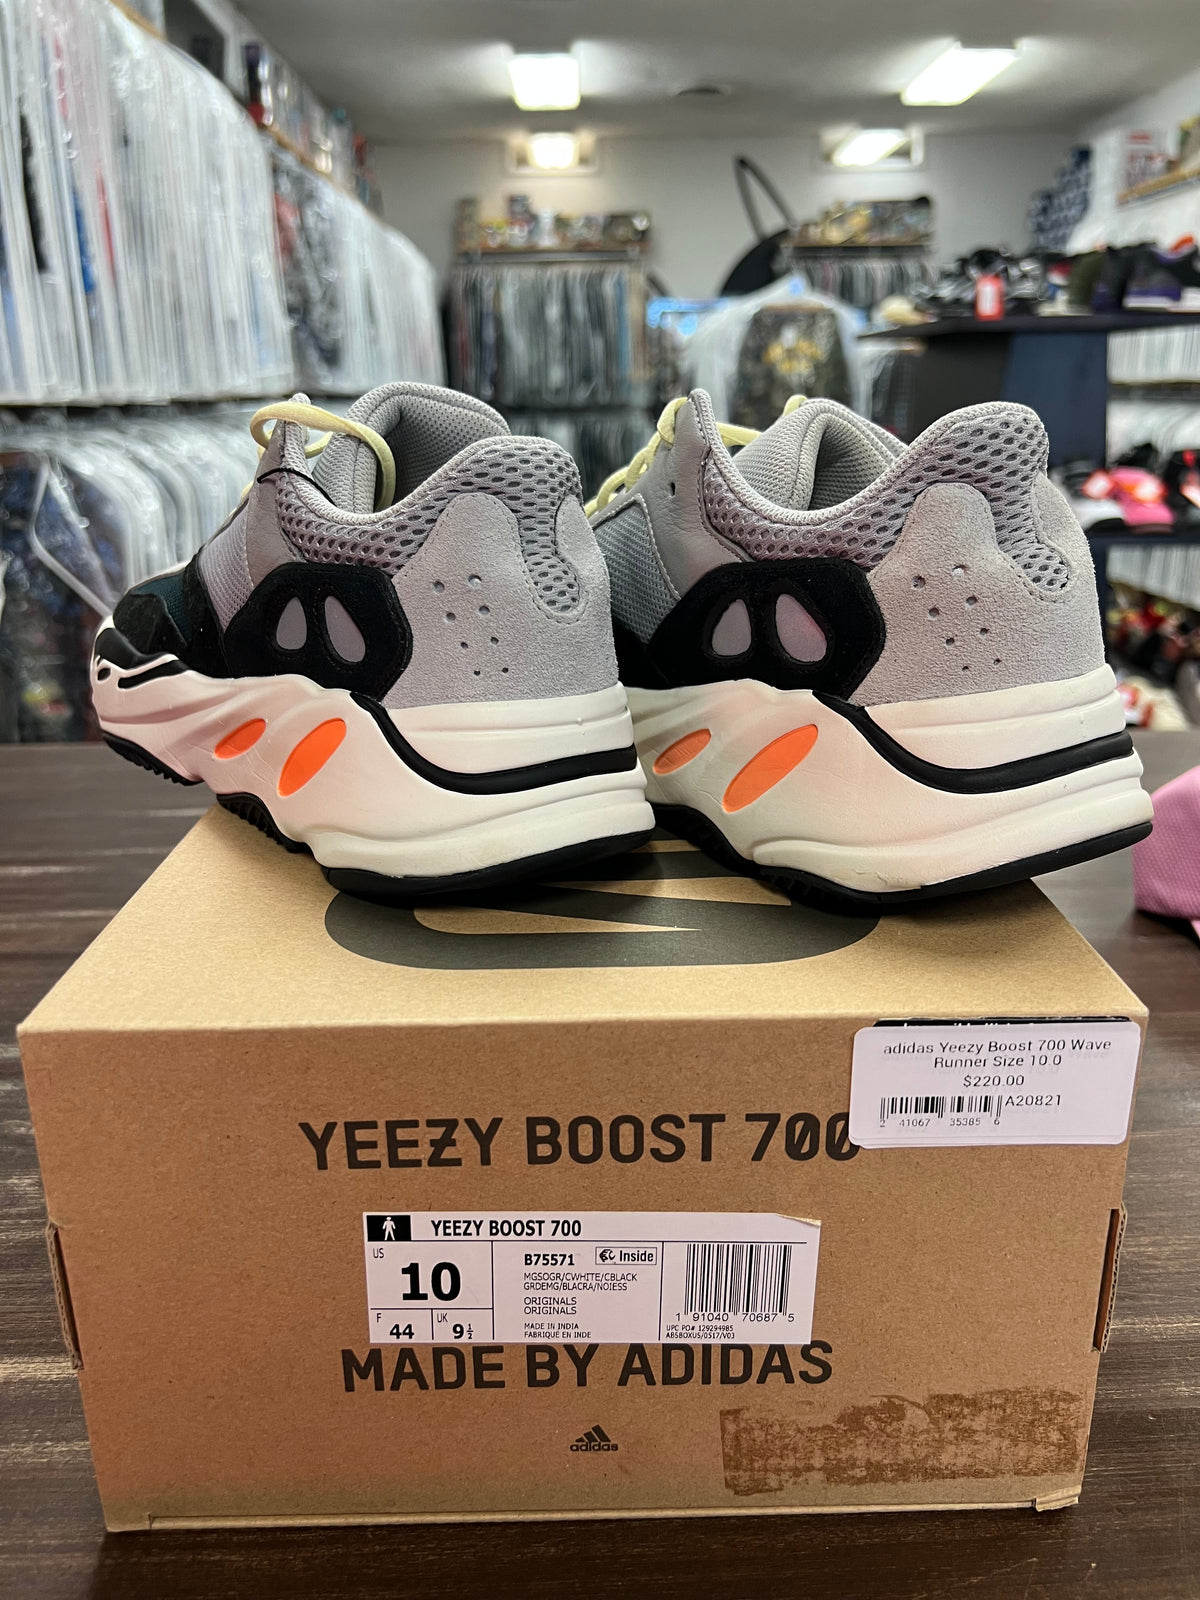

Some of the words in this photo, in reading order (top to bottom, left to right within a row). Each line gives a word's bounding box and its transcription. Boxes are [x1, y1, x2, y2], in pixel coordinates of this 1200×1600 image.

[883, 1041, 934, 1054] adidas
[939, 1041, 984, 1056] Yeezy
[988, 1040, 1033, 1052] Boost
[1038, 1039, 1066, 1051] 700
[1070, 1038, 1112, 1050] Wave
[934, 1056, 988, 1069] Runner
[993, 1055, 1024, 1067] Size
[1030, 1054, 1062, 1066] 10.0
[963, 1075, 1025, 1088] $220.00
[1005, 1094, 1062, 1107] A20821
[879, 1120, 886, 1128] 2
[899, 1118, 931, 1127] 41067
[949, 1117, 981, 1126] 35385
[993, 1117, 1000, 1126] 6
[298, 1116, 503, 1170] YEEZY
[526, 1113, 726, 1165] BOOST
[745, 1111, 861, 1162] 700
[431, 1220, 484, 1236] YEEZY
[489, 1220, 546, 1236] BOOST
[551, 1220, 582, 1237] 700
[372, 1248, 385, 1259] US
[619, 1250, 654, 1262] Inside
[524, 1254, 575, 1266] B75571
[401, 1262, 461, 1301] 10
[523, 1272, 638, 1282] MGSOGR/CWHITE/CBLACK
[523, 1282, 628, 1292] GRDEMG/BLACRA/NOIESS
[523, 1297, 577, 1306] ORIGINALS
[523, 1306, 577, 1315] ORIGINALS
[376, 1313, 382, 1323] F
[437, 1313, 448, 1323] UK
[675, 1312, 681, 1322] 1
[692, 1312, 729, 1322] 91040
[742, 1313, 778, 1322] 70687
[787, 1313, 795, 1322] 5
[389, 1323, 415, 1339] 44
[524, 1331, 560, 1339] FABRIQUE
[342, 1345, 505, 1393] MADE
[527, 1344, 599, 1388] BY
[617, 1340, 834, 1387] ADIDAS
[569, 1441, 619, 1452] adidas
